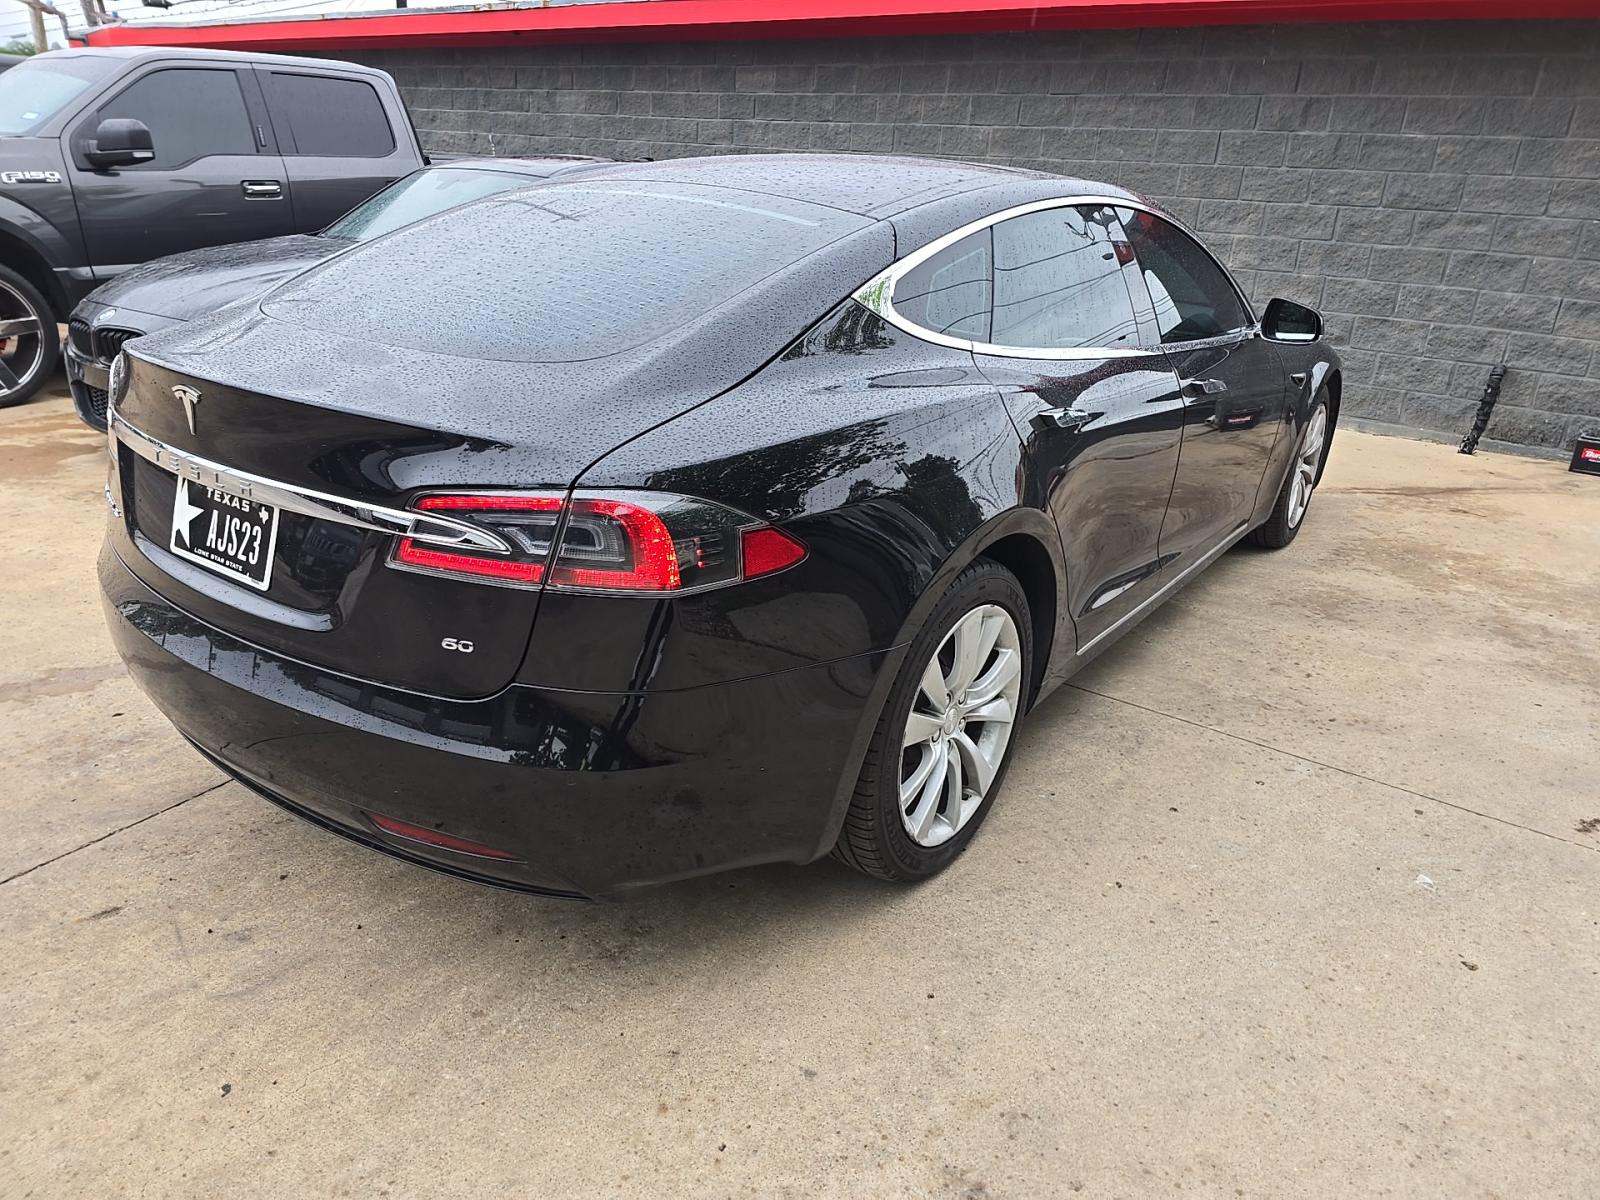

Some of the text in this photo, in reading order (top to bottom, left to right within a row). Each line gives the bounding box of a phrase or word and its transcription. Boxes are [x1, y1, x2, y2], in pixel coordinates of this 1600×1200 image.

[153, 448, 252, 497] TESLA
[206, 486, 250, 513] TEXAS
[206, 509, 262, 565] AJS23
[193, 547, 243, 572] LONE STAR STATE
[441, 637, 474, 653] 60
